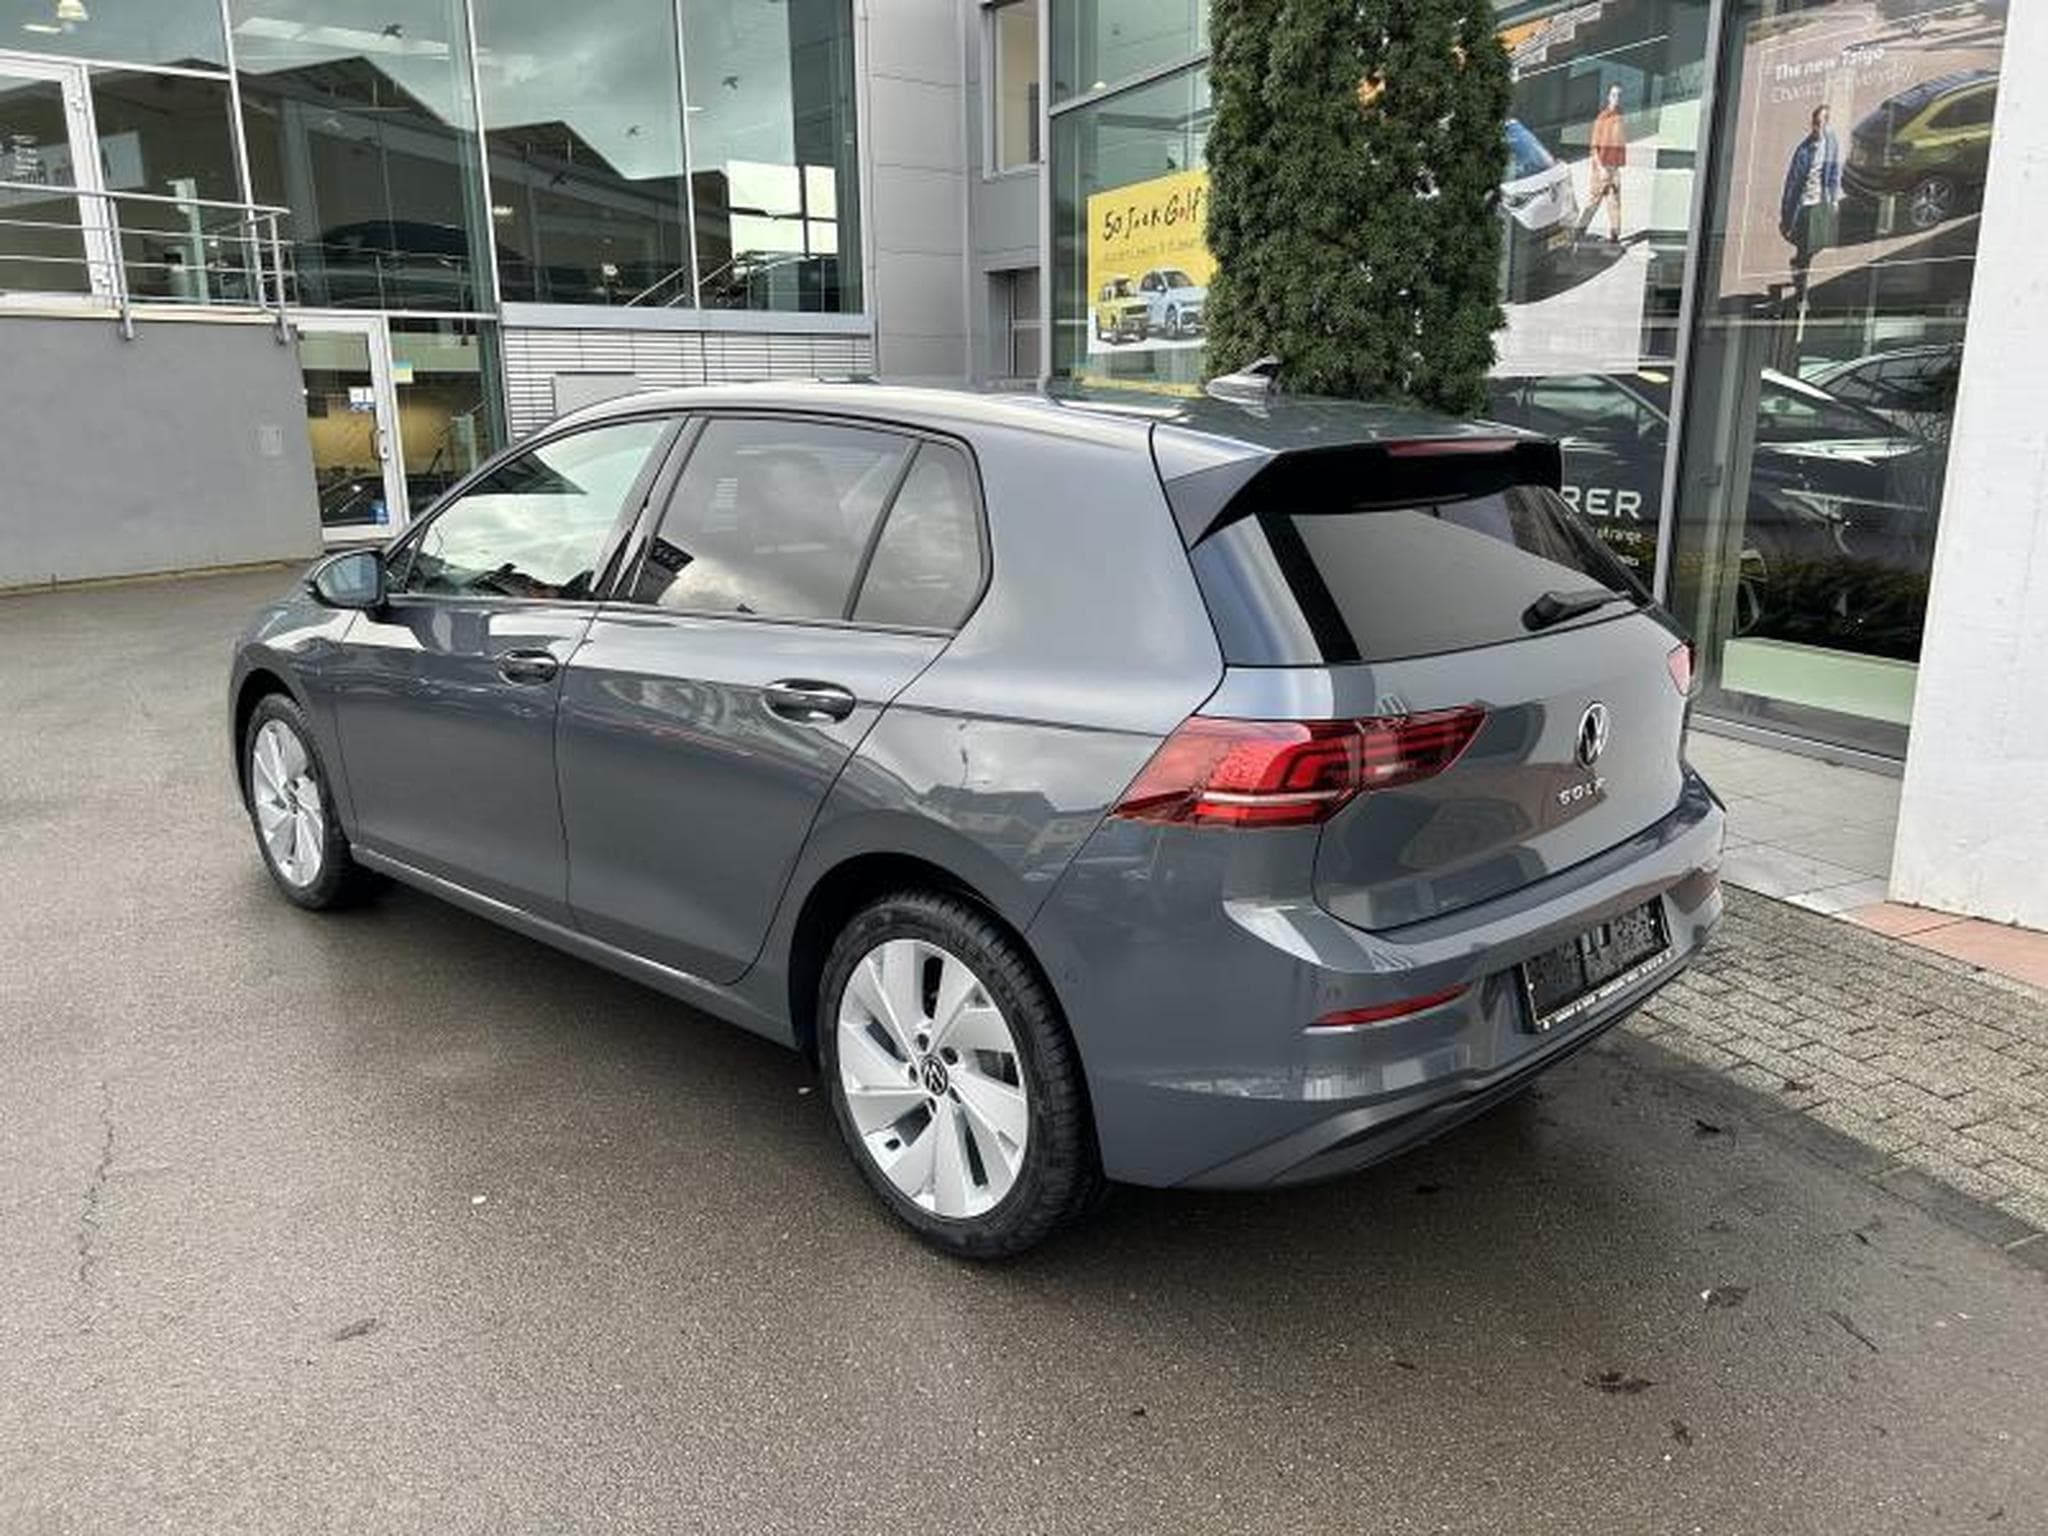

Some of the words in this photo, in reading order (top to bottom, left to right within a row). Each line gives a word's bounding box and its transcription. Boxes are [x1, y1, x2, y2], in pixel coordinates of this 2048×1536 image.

[1102, 210, 1122, 241] 50
[1164, 185, 1203, 226] Golf
[1557, 776, 1606, 806] GOLF
